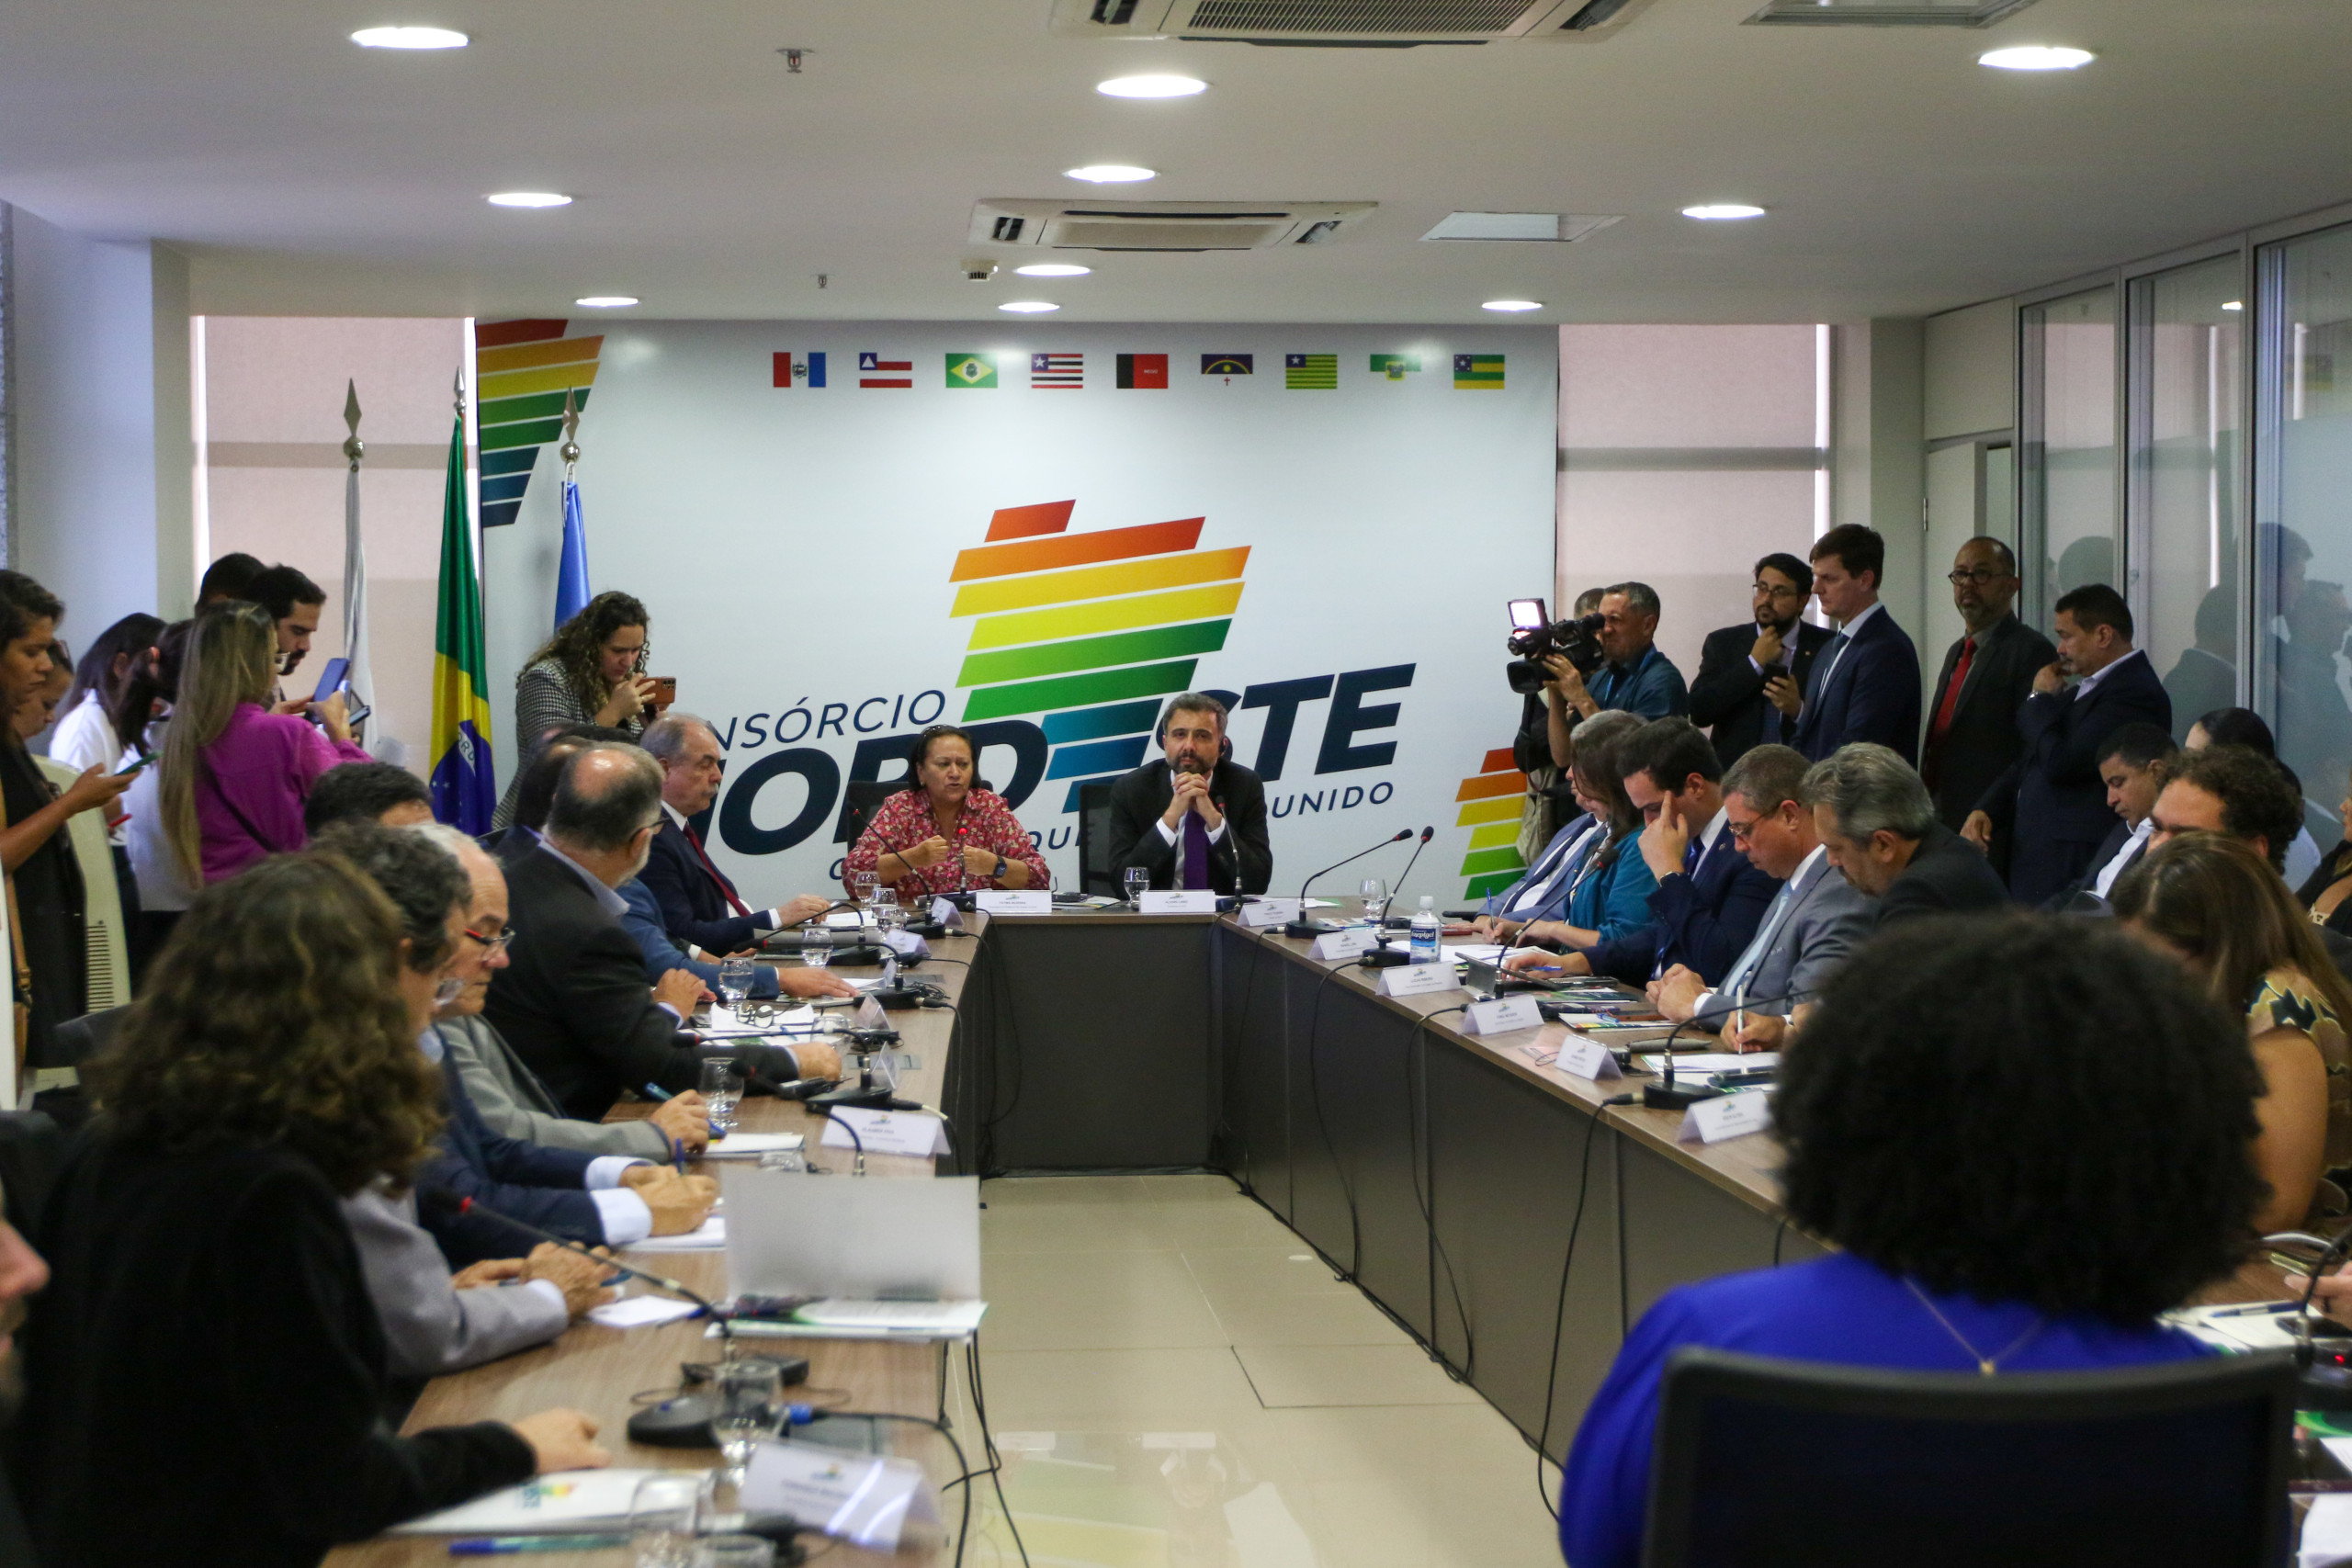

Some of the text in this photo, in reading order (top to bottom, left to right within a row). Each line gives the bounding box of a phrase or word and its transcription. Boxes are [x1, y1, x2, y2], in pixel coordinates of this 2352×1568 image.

[707, 690, 946, 751] NSÓRCIO
[1028, 781, 1394, 852] QU UNIDO
